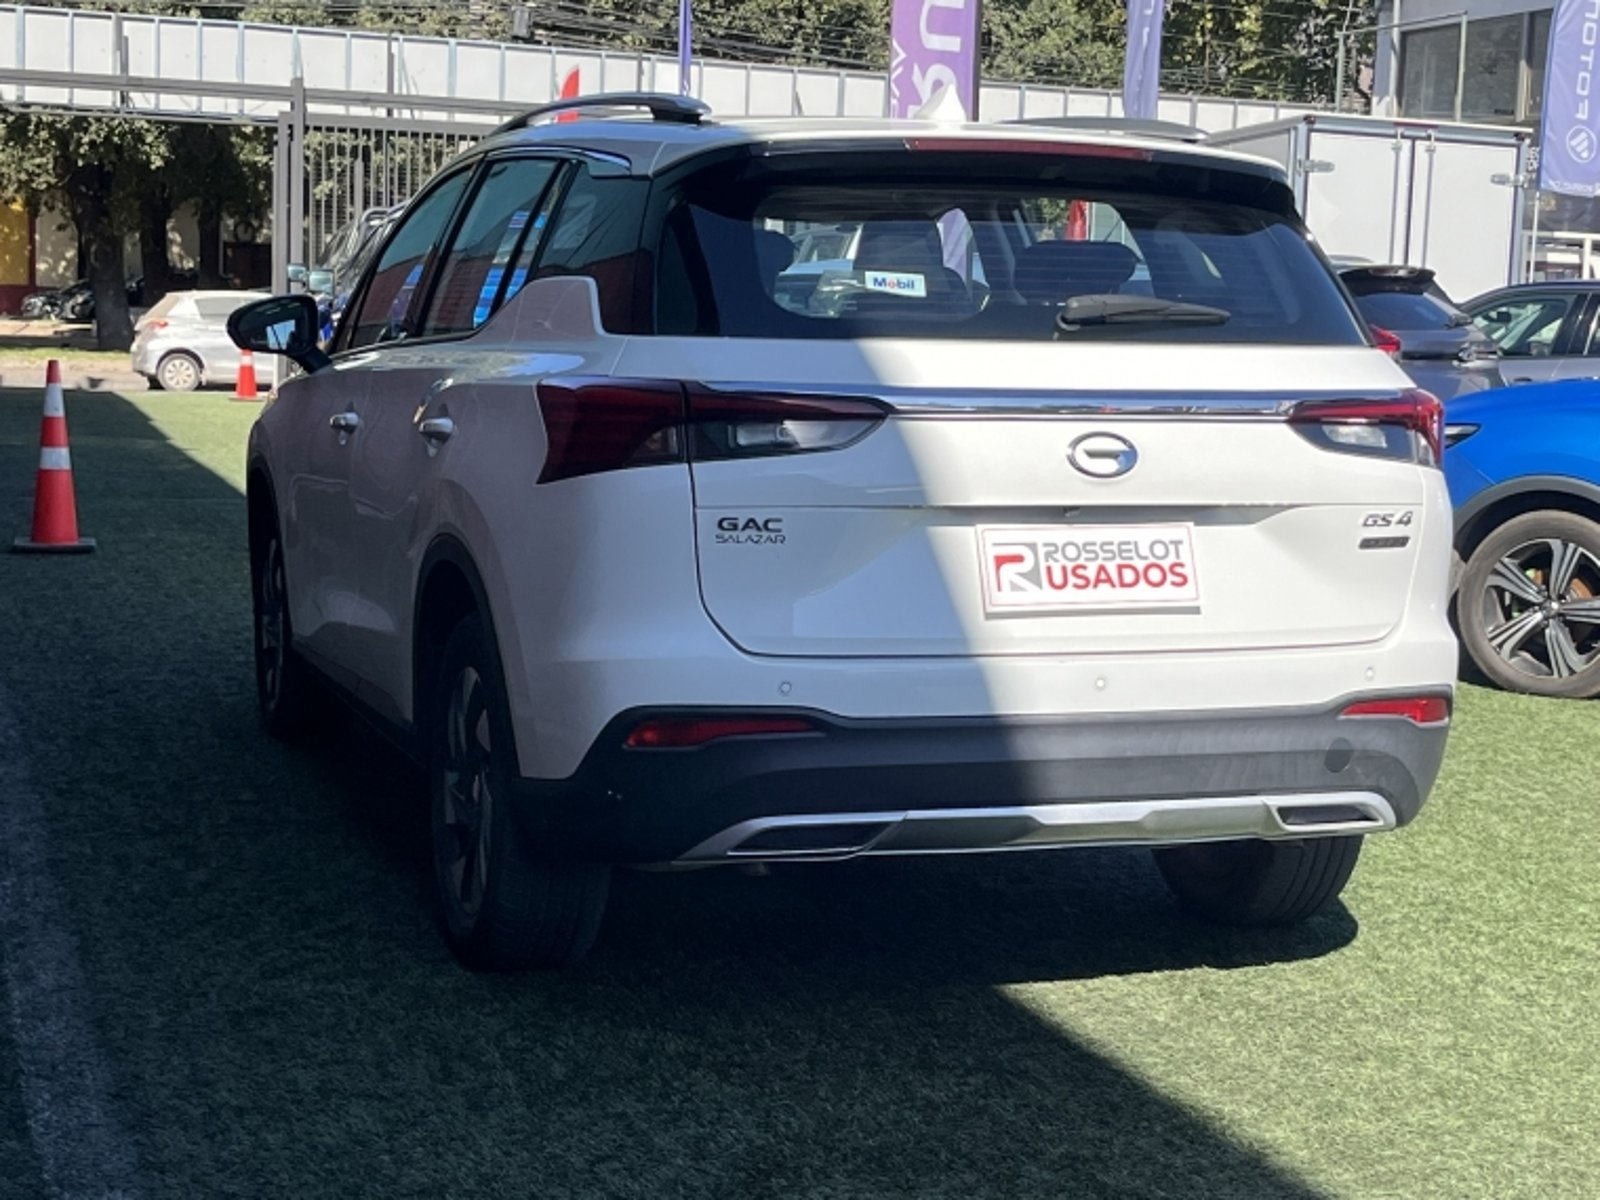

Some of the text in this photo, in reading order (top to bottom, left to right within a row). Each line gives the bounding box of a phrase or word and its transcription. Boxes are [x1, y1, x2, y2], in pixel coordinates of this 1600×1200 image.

[873, 277, 915, 289] Mobil
[717, 517, 784, 533] GAC
[715, 534, 786, 544] SALAZAR
[1042, 539, 1184, 563] ROSSELOT
[1045, 562, 1189, 590] USADOS
